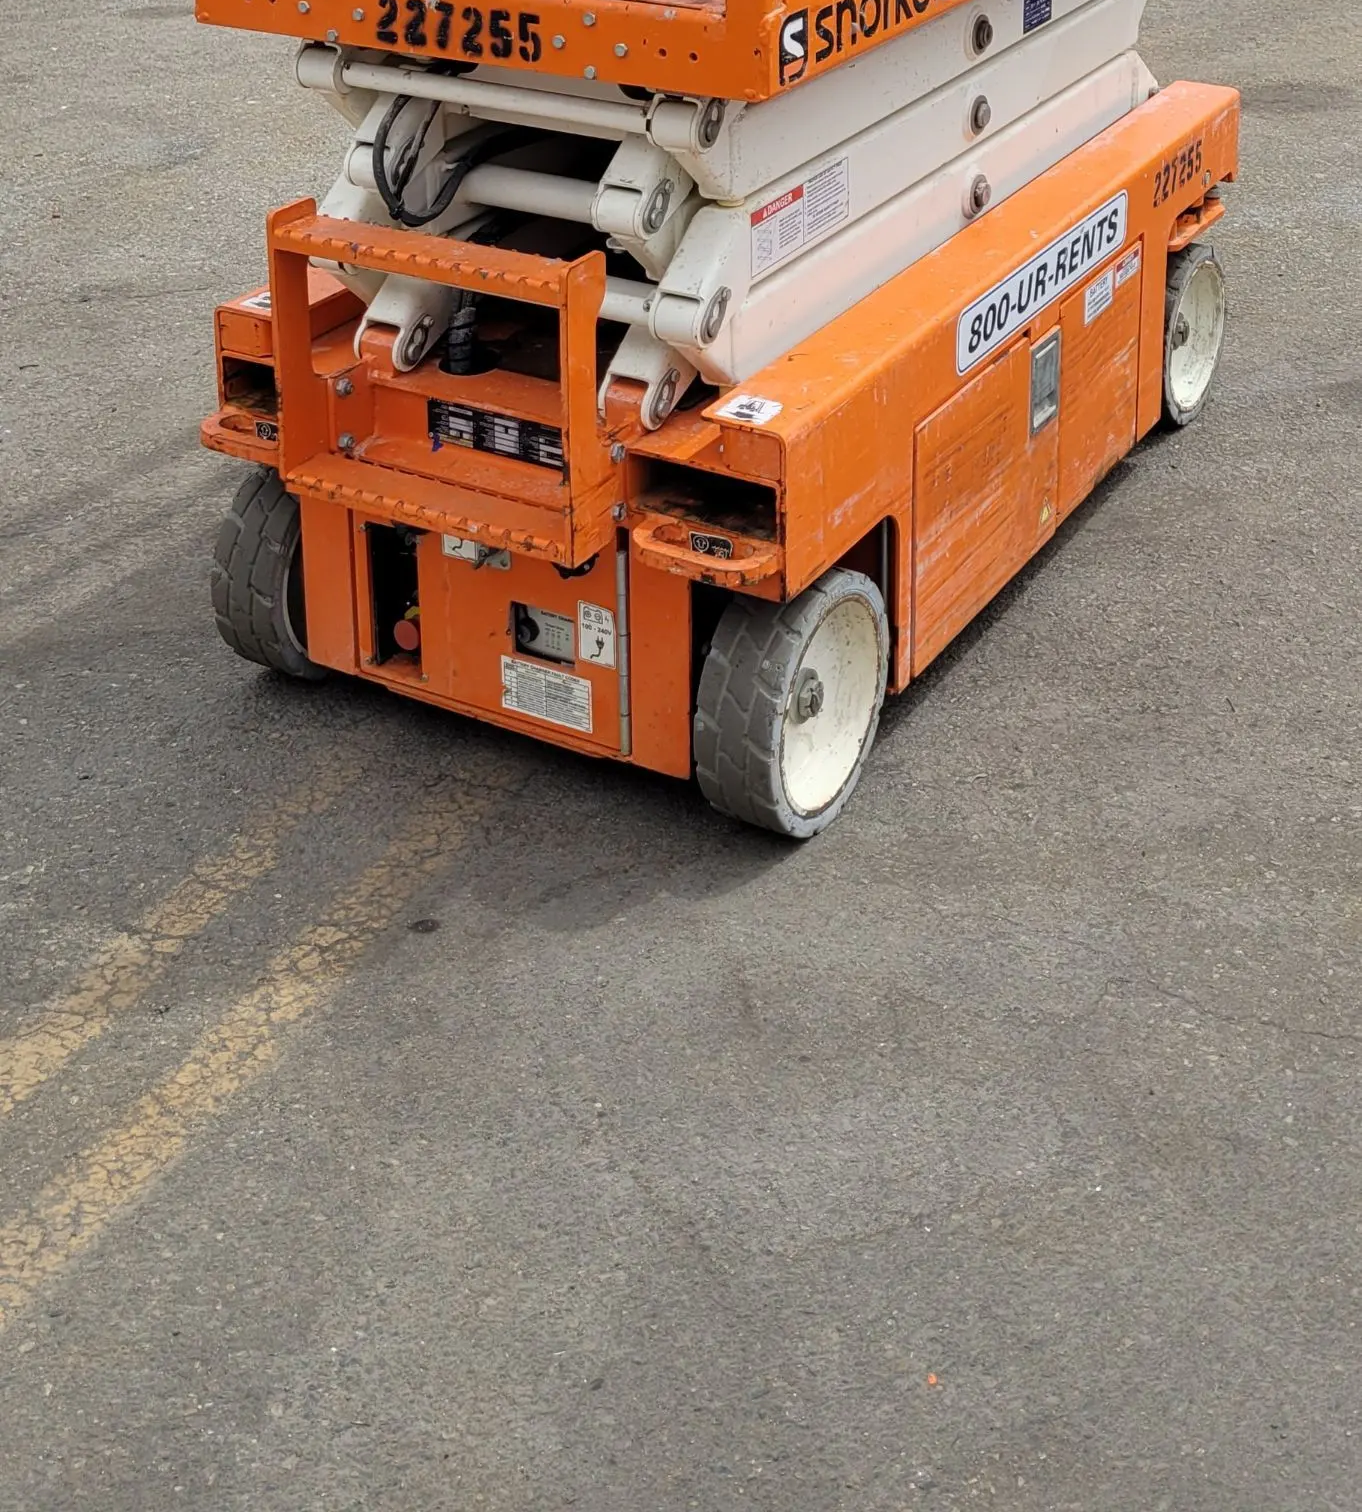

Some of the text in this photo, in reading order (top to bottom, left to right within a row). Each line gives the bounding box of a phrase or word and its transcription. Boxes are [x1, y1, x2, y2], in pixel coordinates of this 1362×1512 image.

[766, 192, 793, 216] DANGER
[1153, 139, 1202, 208] 227255
[968, 207, 1119, 354] 800-UR-RENTS
